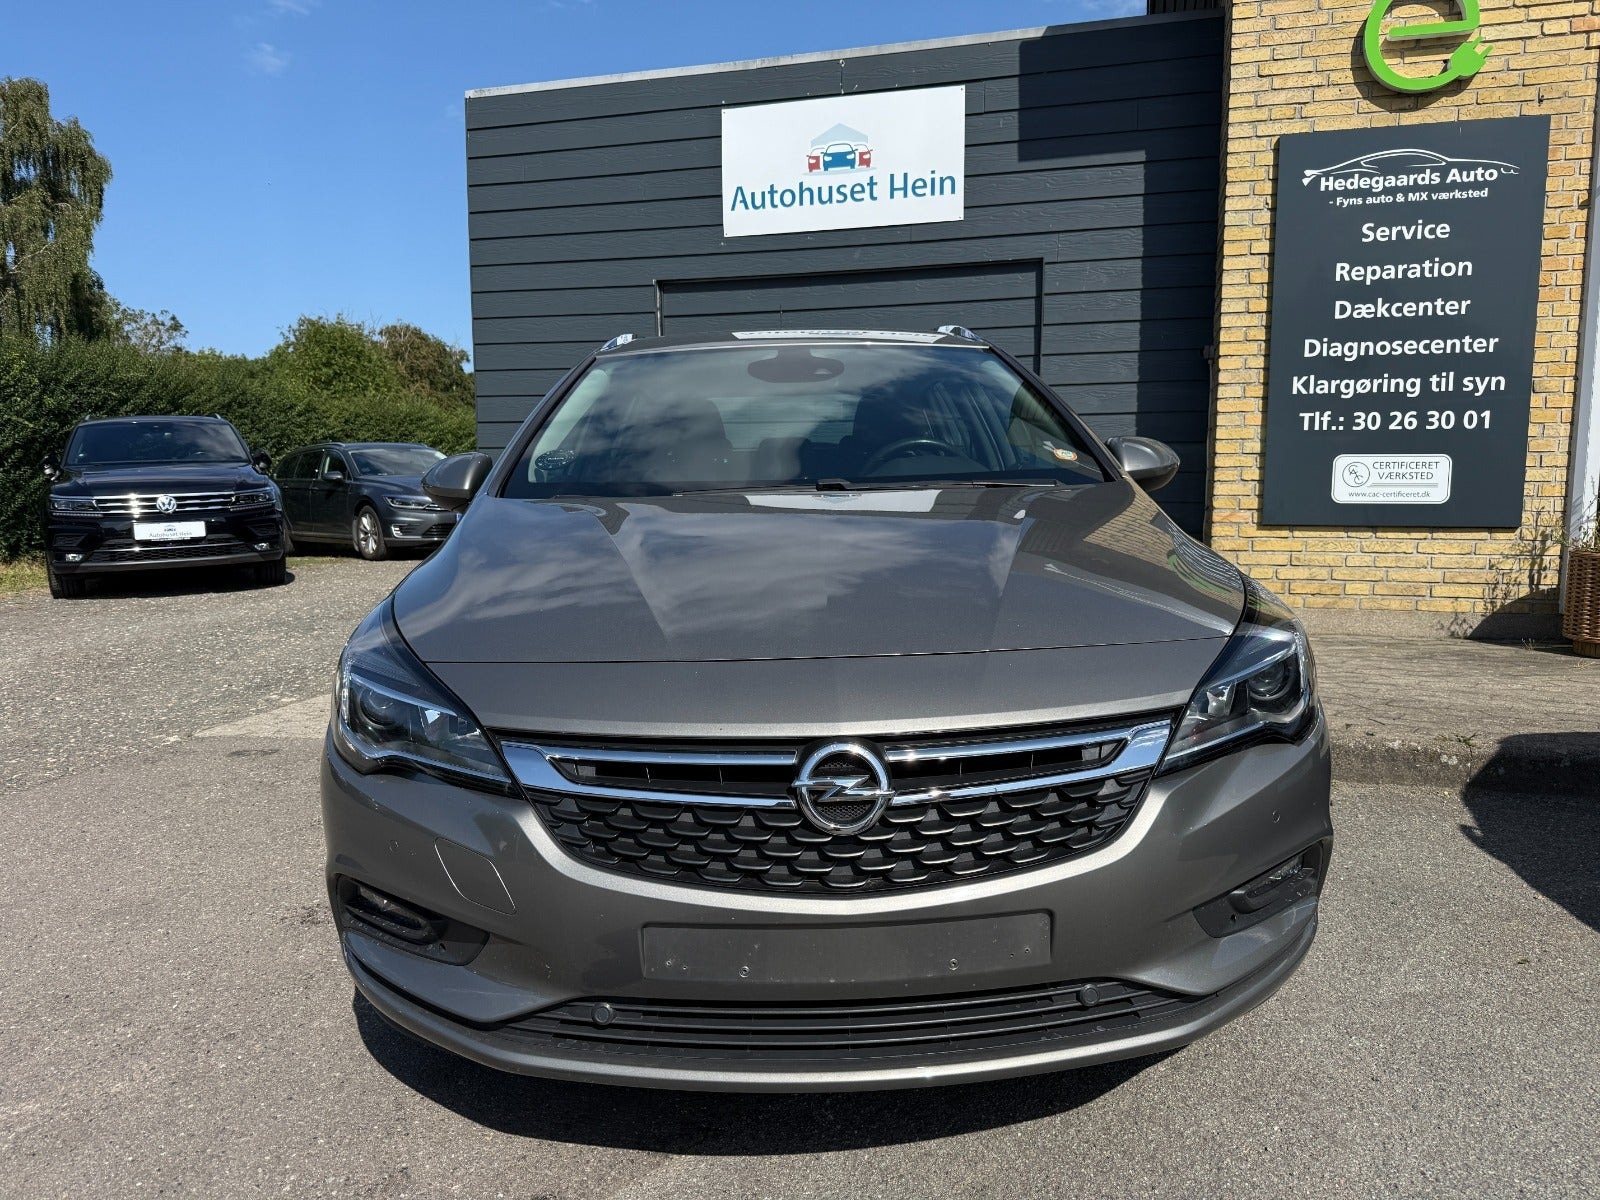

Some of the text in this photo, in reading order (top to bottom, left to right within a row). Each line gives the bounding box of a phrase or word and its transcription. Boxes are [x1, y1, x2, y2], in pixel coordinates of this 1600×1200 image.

[731, 170, 956, 211] Autohuset Hein
[1320, 167, 1498, 192] Hedegaards Auto
[1336, 197, 1363, 207] Fyns
[1366, 194, 1393, 204] auto
[1396, 193, 1405, 203] &
[1408, 191, 1428, 201] MX
[1431, 188, 1488, 199] værksted
[1361, 219, 1450, 242] Service
[1335, 257, 1472, 285] Reparation
[1334, 298, 1471, 319] Dækcenter
[1304, 335, 1499, 361] Diagnosecenter
[1292, 372, 1506, 398] Klargøring til syn
[1299, 410, 1491, 430] Tlf.: 30 26 30 01
[1372, 461, 1440, 469] CERTIFICERET
[1377, 471, 1434, 480] VÆRKSTED
[1348, 490, 1431, 498] www.cac-certificeret.dk
